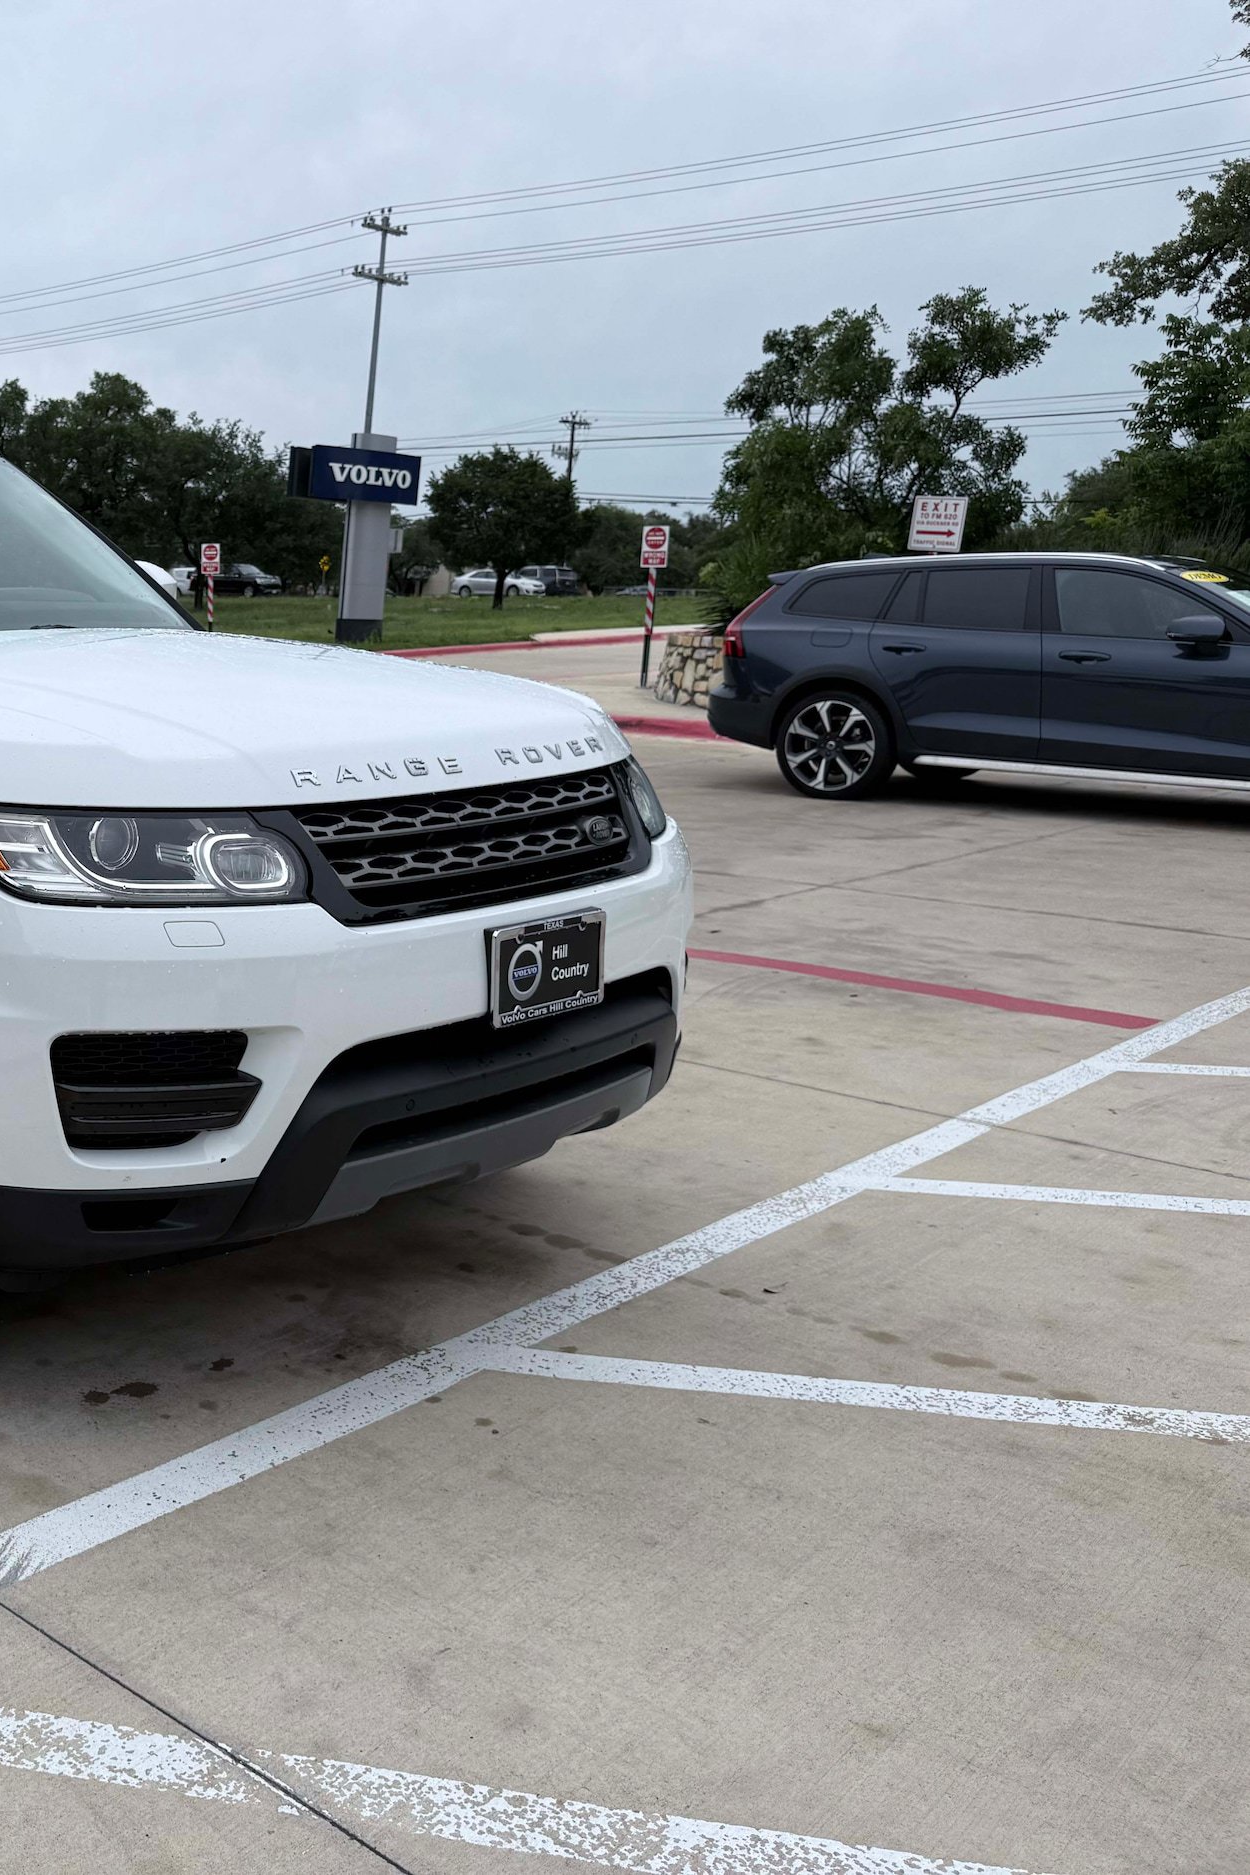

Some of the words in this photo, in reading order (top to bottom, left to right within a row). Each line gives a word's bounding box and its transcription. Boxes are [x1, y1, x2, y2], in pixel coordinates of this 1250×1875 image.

[328, 462, 412, 490] VOLVO
[921, 502, 959, 512] EXIT
[290, 756, 464, 788] RANGE
[494, 736, 604, 766] ROVER
[543, 920, 564, 930] TEXAS
[552, 944, 568, 960] Hill
[513, 966, 538, 978] VOLVO
[551, 963, 589, 981] Country
[502, 1011, 526, 1024] Volvo
[528, 1008, 548, 1019] Cars
[549, 1003, 563, 1012] Hill
[565, 995, 598, 1009] Country
